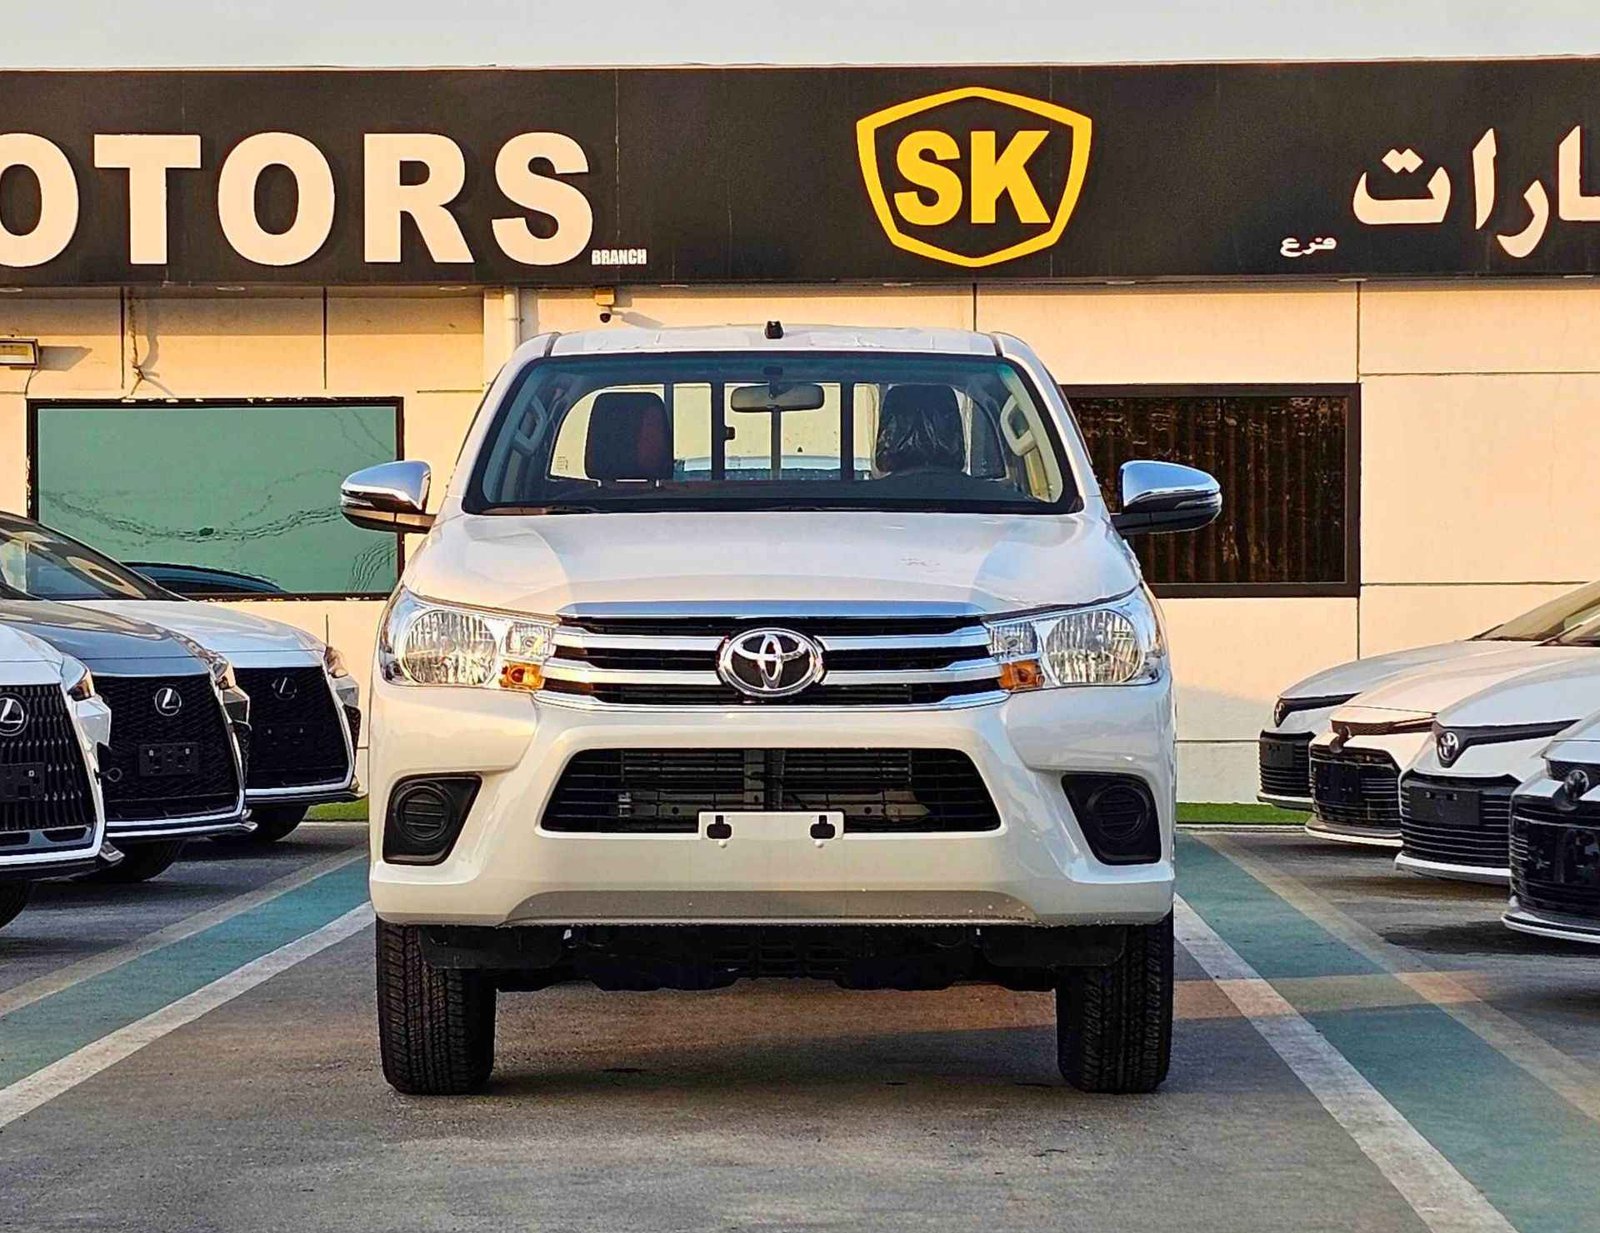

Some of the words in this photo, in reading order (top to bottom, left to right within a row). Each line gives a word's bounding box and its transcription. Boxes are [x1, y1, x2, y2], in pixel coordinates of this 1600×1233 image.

[893, 129, 1051, 227] SK
[1352, 124, 1600, 259] ارات
[591, 248, 648, 266] BRANCH
[1280, 237, 1337, 258] فرع
